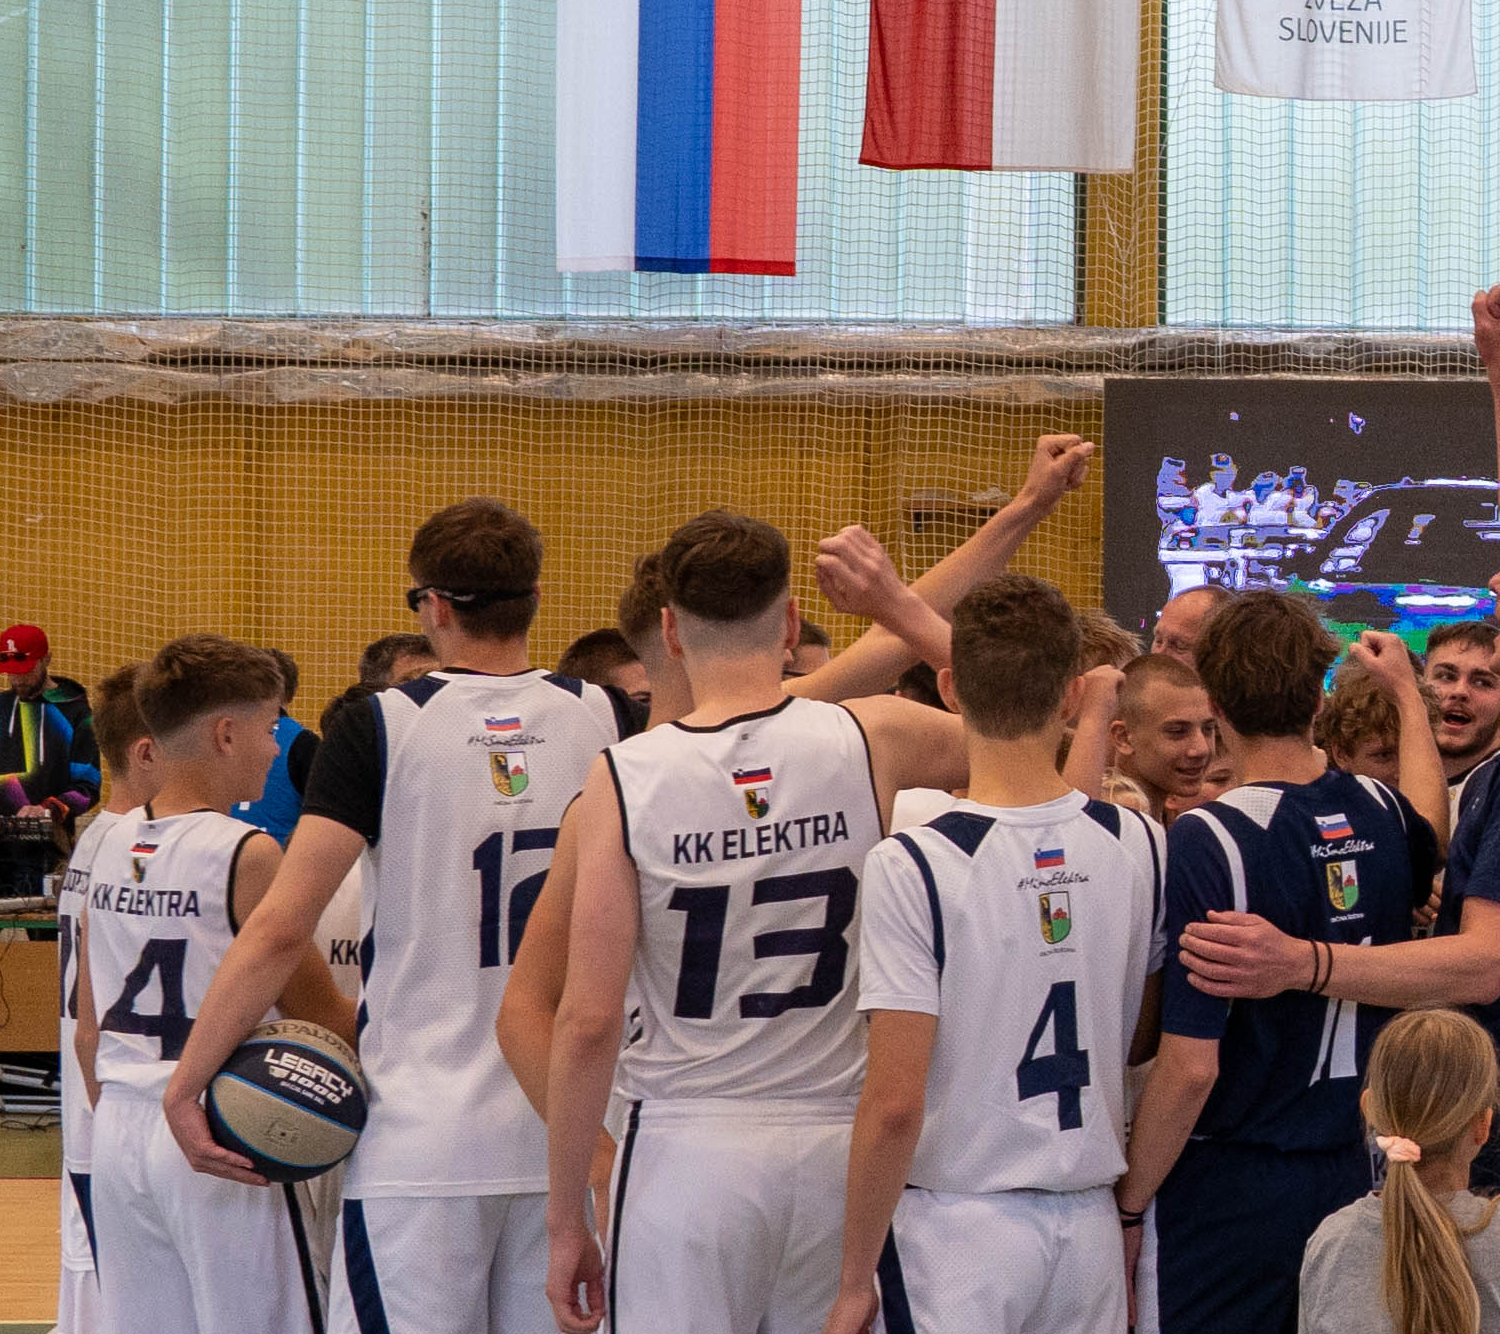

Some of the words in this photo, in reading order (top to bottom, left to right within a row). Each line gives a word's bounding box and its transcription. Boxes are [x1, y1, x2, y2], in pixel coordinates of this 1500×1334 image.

[1277, 17, 1409, 45] SLOVENIJE
[672, 830, 716, 865] KK
[721, 810, 851, 861] ELEKTRA
[89, 881, 112, 913] KK
[114, 886, 202, 919] ELEKTRA
[329, 938, 361, 966] KK
[666, 865, 860, 1020] 13
[99, 937, 198, 1062] 4
[263, 1047, 355, 1098] LEGACY
[1016, 979, 1092, 1132] 4
[287, 1069, 343, 1105] 1000
